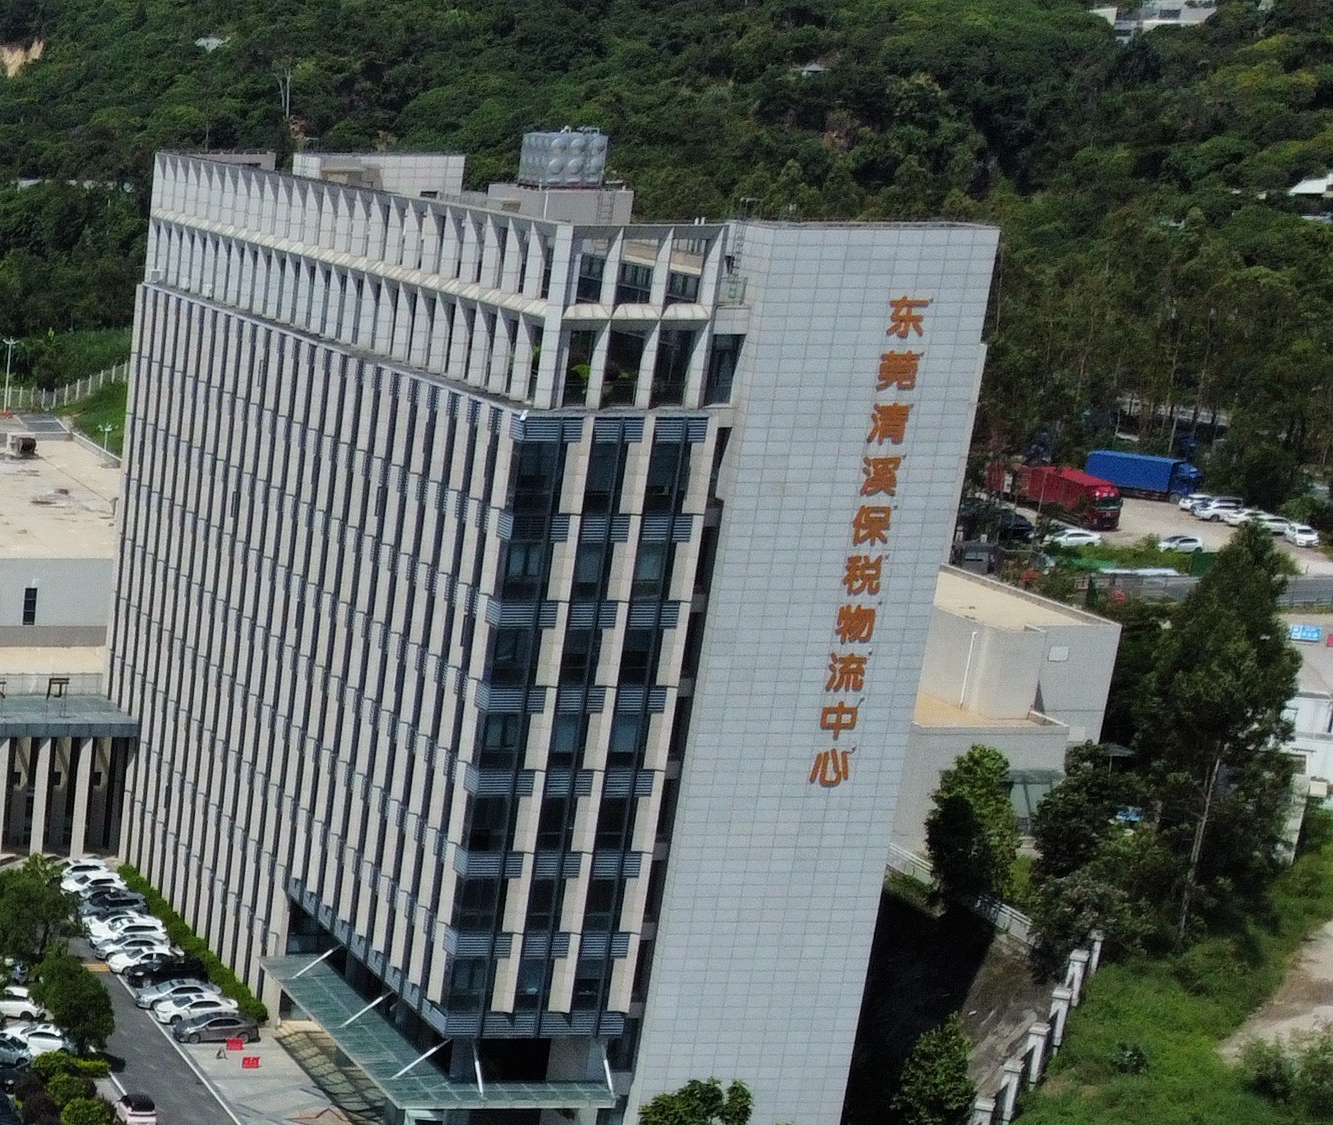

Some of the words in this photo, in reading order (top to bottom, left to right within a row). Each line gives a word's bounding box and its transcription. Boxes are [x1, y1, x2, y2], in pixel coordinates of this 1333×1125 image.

[809, 296, 930, 788] 东莞清溪保税物流中心
